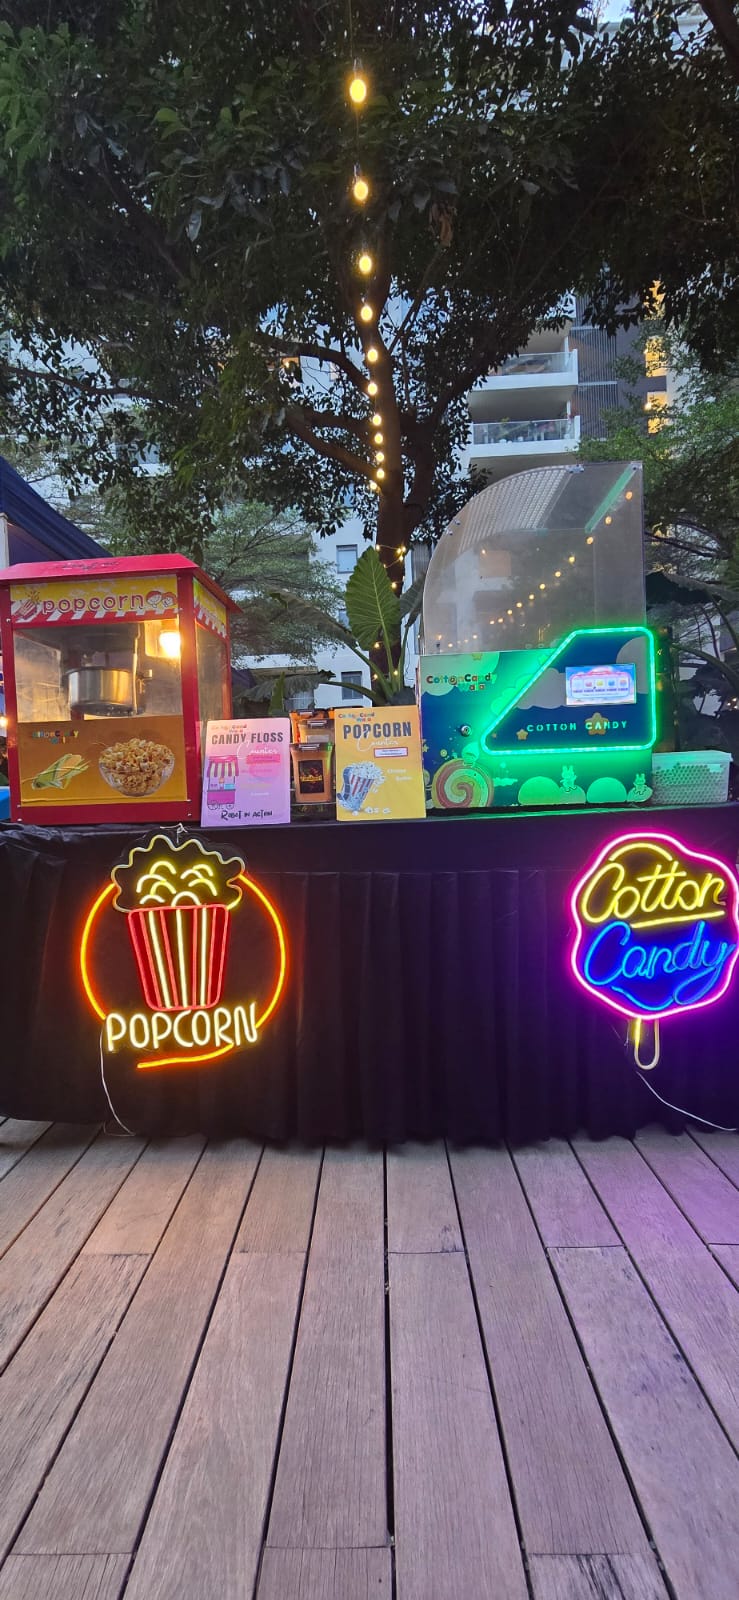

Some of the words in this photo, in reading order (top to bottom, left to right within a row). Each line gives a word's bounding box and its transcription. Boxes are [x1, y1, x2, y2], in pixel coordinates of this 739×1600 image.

[42, 594, 144, 614] popcorn
[343, 721, 412, 740] POPCORN
[526, 722, 577, 732] COTTON
[584, 720, 627, 731] CANDY
[212, 732, 247, 745] CANDY
[250, 732, 284, 744] FLOSS
[581, 860, 726, 923] Cotton
[584, 919, 737, 1006] Candy
[106, 1002, 258, 1051] POPCORN
